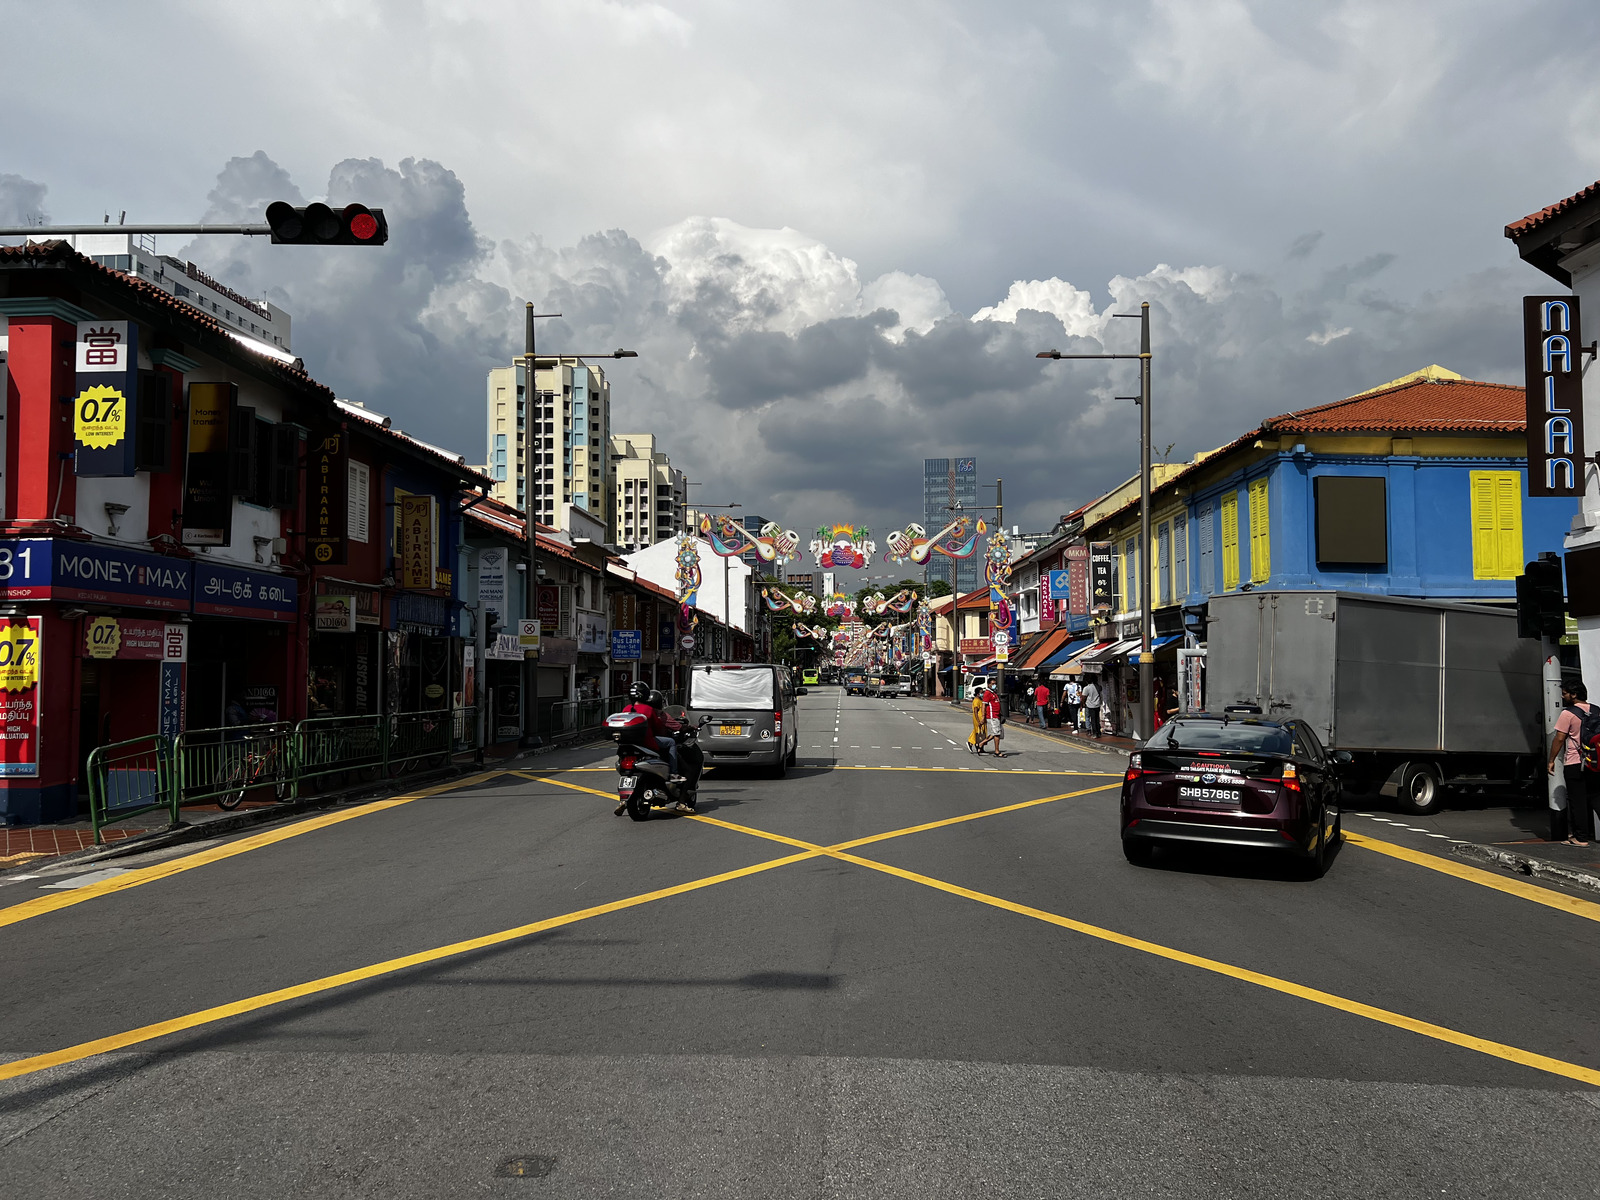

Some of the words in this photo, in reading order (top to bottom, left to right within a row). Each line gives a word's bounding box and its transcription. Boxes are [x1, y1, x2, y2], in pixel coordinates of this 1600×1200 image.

[1097, 567, 1107, 575] TEA
[612, 636, 625, 644] Bus
[625, 636, 640, 644] Lane
